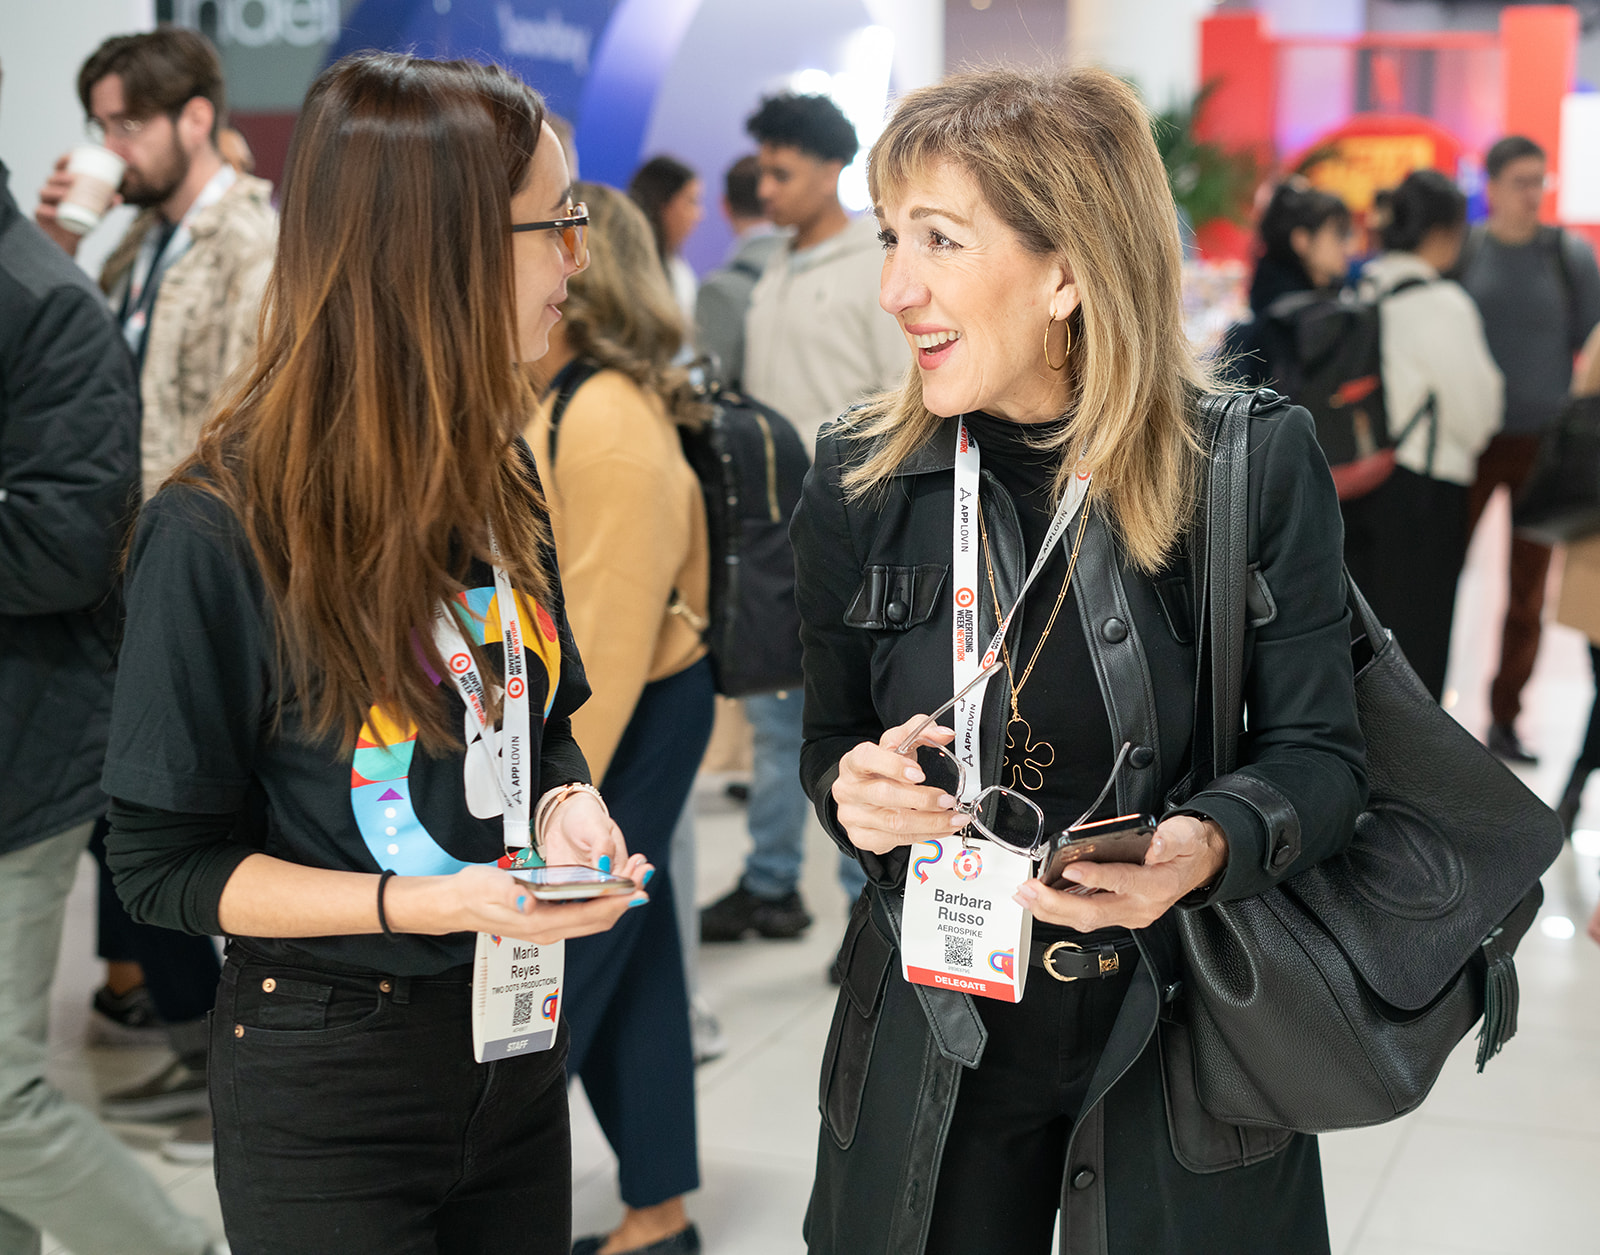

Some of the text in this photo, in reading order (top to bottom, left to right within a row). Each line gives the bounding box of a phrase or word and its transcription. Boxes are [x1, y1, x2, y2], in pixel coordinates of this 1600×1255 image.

[960, 504, 970, 553] APPLOVIN
[1043, 510, 1068, 553] APPLOVIN
[956, 609, 965, 630] WEEK
[965, 609, 974, 653] ADVERTISING
[505, 629, 515, 675] ADVERTISING
[514, 654, 522, 675] WEEK
[459, 675, 474, 697] WEEK
[965, 703, 977, 751] APPLOVIN
[511, 736, 520, 786] APPLOVIN
[934, 889, 991, 911] Barbara
[937, 906, 985, 926] Russo
[937, 924, 983, 938] AEROSPIKE
[513, 944, 539, 961] Maria
[511, 964, 541, 980] Reyes
[492, 977, 557, 995] TWO DOTS PRODUCTIONS
[934, 975, 987, 992] DELEGATE
[507, 1040, 528, 1052] STAFF
